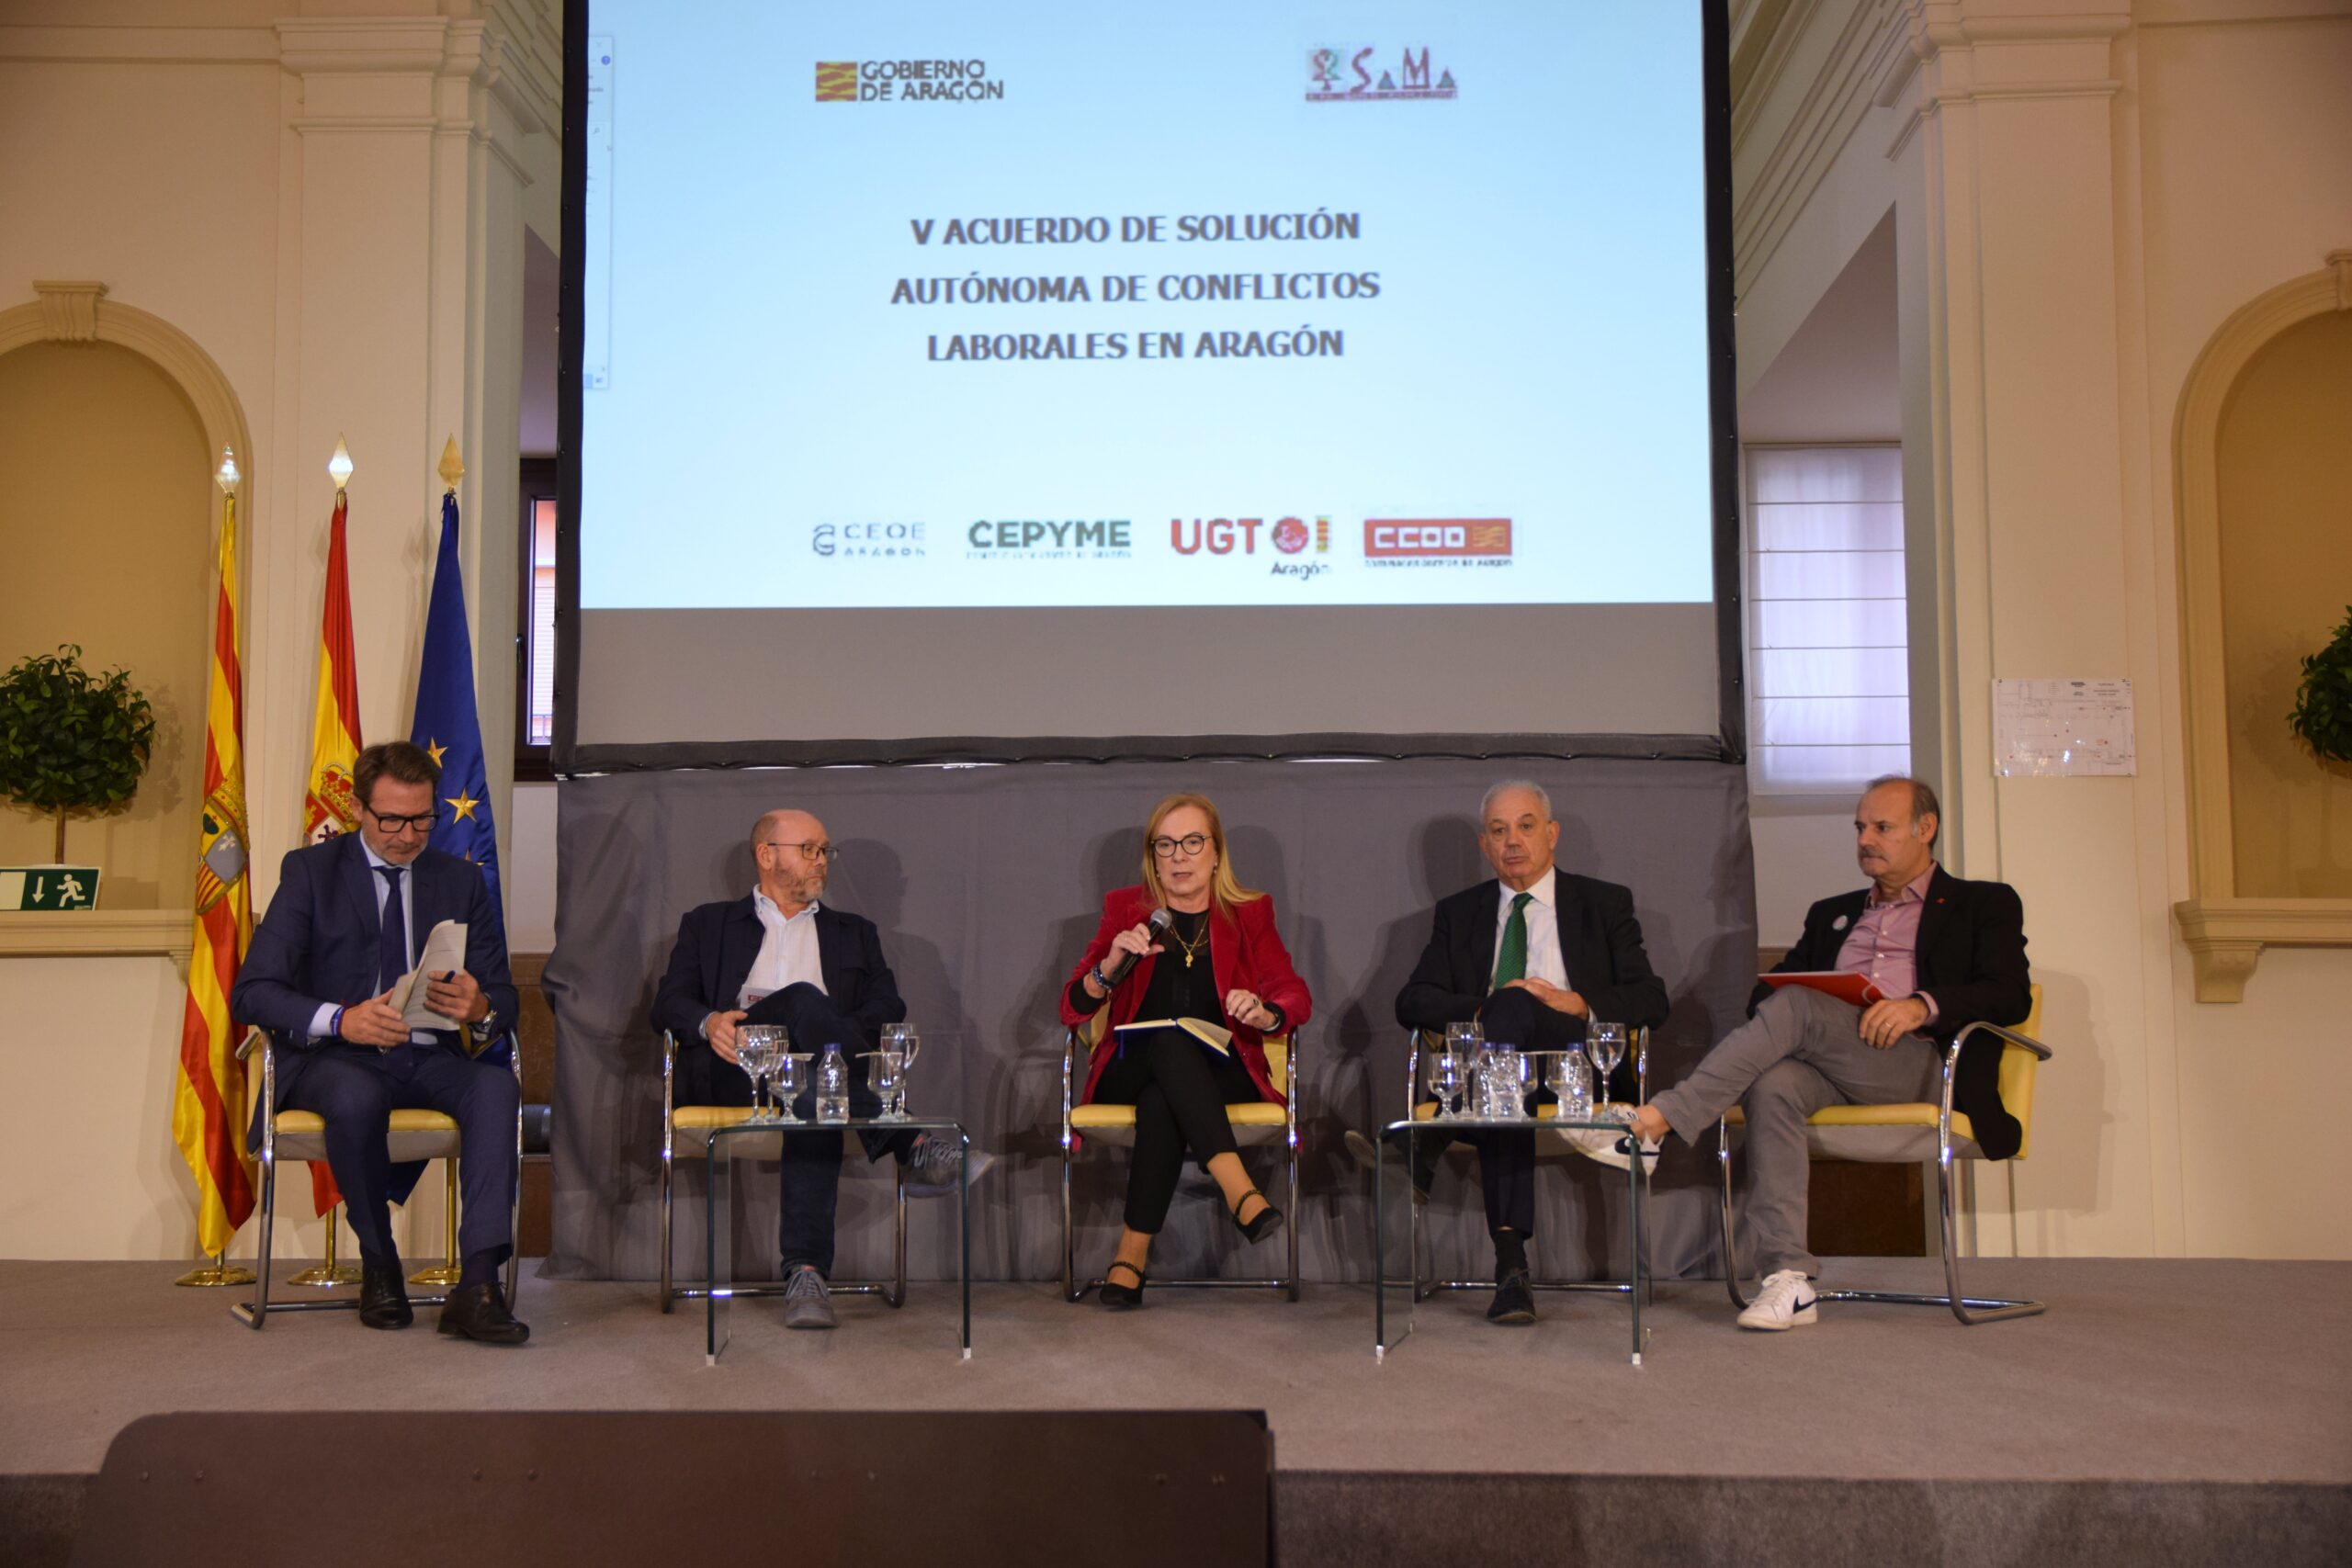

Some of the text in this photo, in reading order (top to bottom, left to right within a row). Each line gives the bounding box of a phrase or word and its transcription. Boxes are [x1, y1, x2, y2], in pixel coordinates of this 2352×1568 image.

[860, 60, 985, 80] GOBIERNO
[860, 82, 893, 101] DE
[910, 208, 1362, 245] V ACUERDO DE SOLUCIÓN
[890, 272, 1381, 304] AUTÓNOMA DE CONFLICTOS
[928, 325, 1344, 361] LABORALES EN ARAGÓN
[843, 523, 925, 540] CEOE
[967, 520, 1131, 548] CEPYME
[1170, 518, 1263, 555] UGT
[1374, 526, 1465, 548] CCOO
